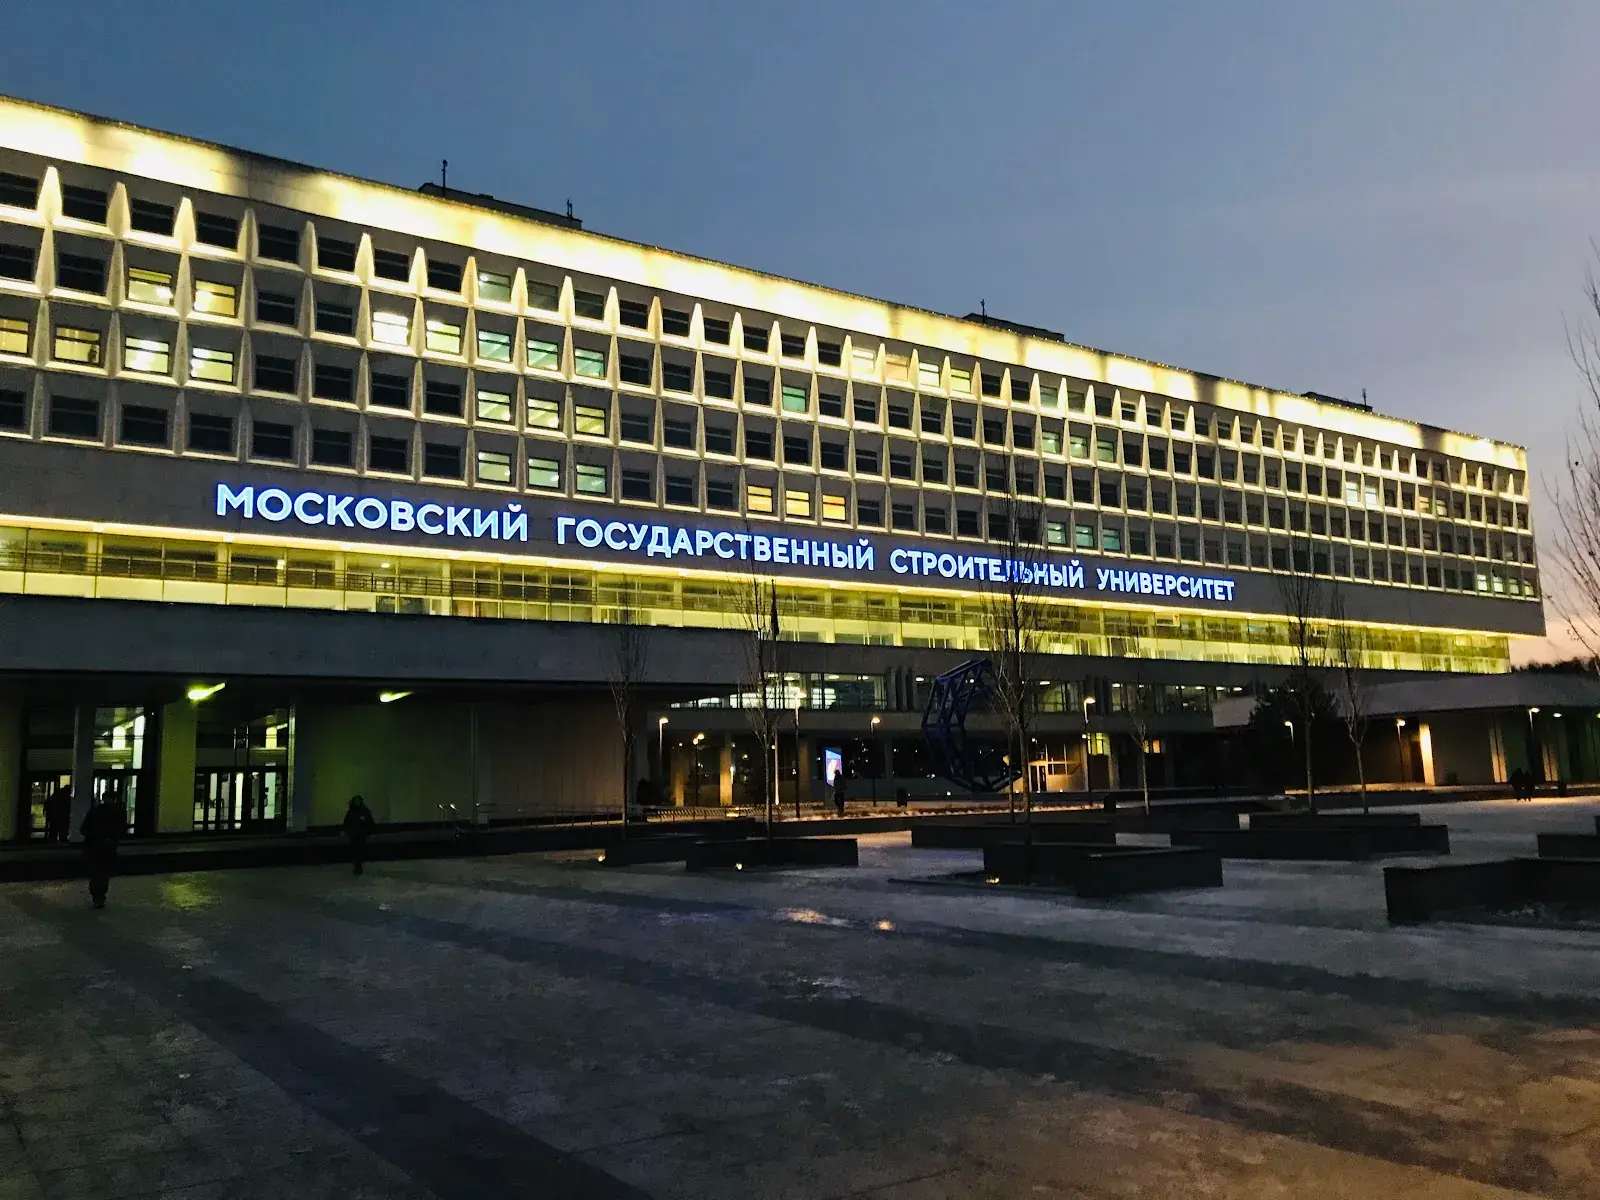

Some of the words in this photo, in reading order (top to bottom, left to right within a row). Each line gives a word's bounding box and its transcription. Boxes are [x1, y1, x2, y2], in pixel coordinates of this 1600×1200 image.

[216, 483, 528, 542] МОСКОВСКИЙ
[556, 516, 874, 571] ГОСУДАРСТВЕННЫЙ
[889, 548, 1085, 589] СТРОИТЕЛЬНЫЙ
[1096, 567, 1235, 602] УНИВЕРСИТЕТ
